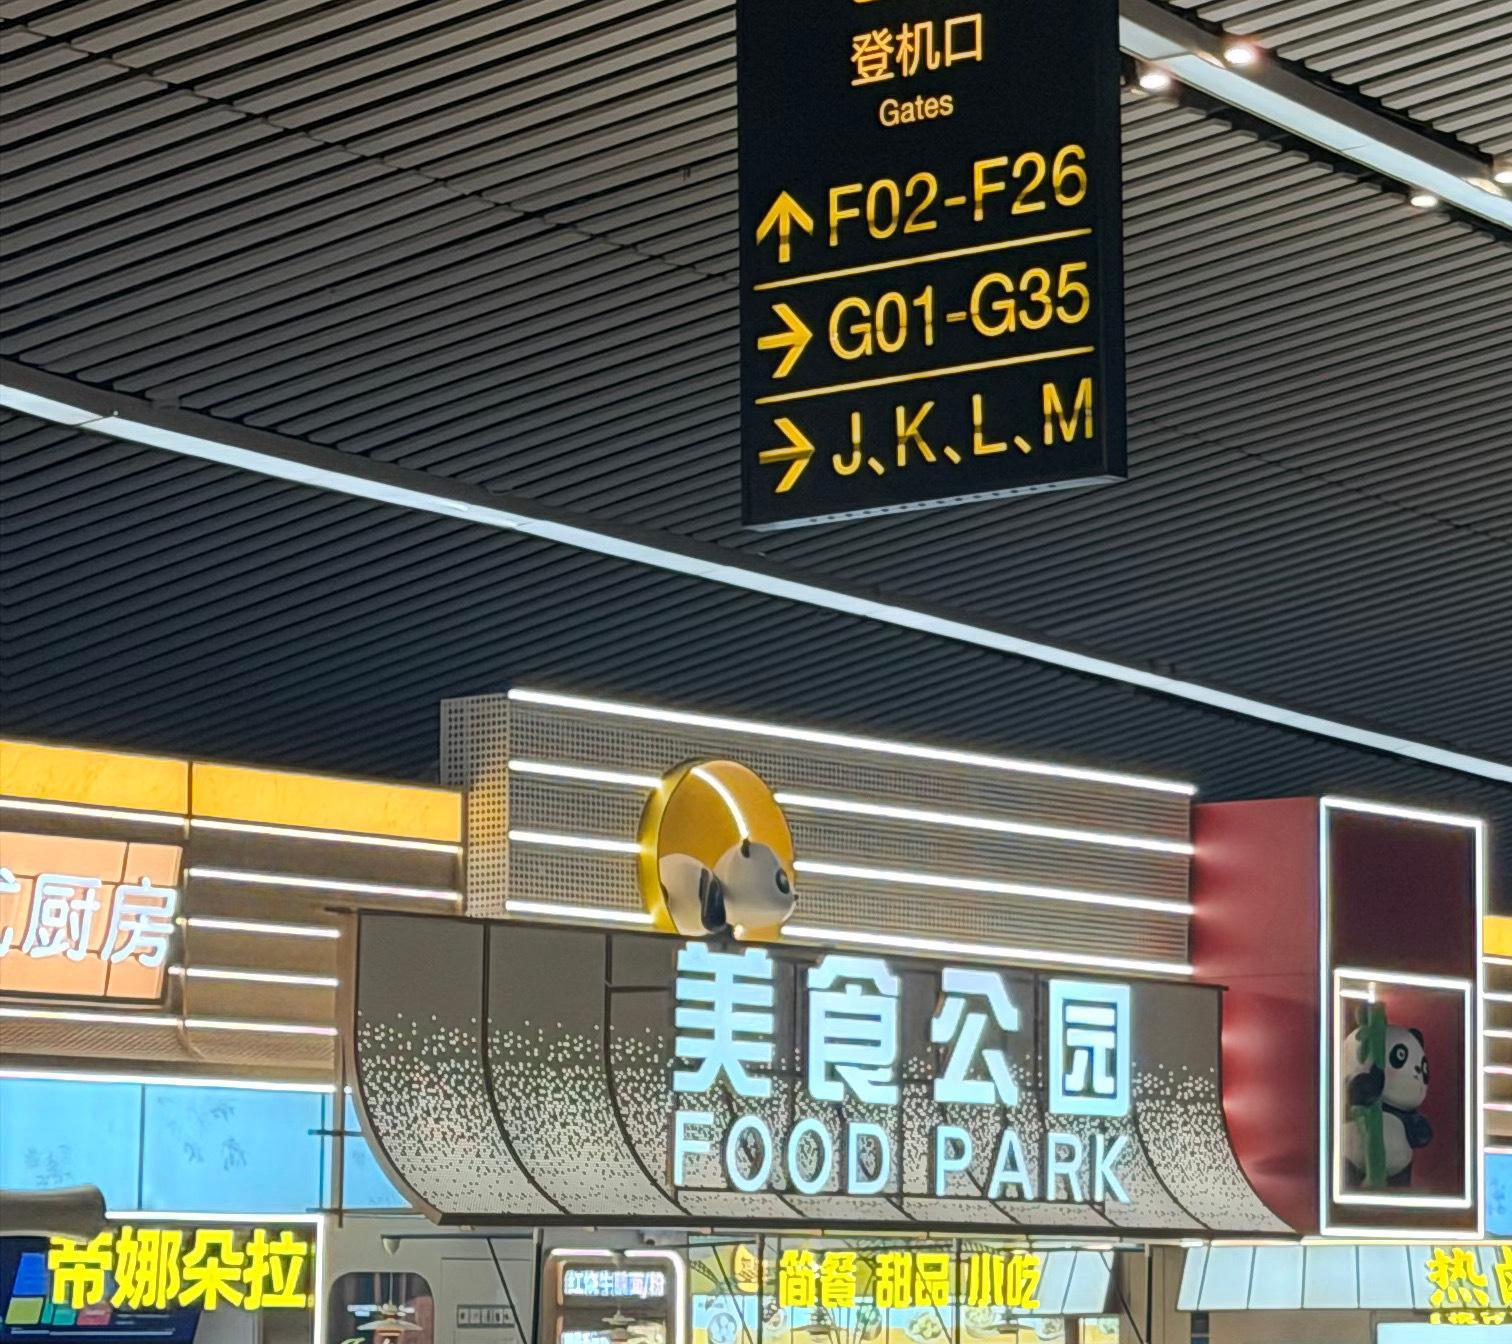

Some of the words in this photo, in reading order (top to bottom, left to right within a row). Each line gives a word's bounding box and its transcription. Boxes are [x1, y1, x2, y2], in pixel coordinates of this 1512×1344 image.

[850, 13, 984, 87] 登机口
[879, 92, 954, 129] Gates
[828, 144, 1088, 247] F02-F26
[829, 262, 1090, 361] G01-G35
[672, 942, 1132, 1117] 美食公园
[674, 1111, 892, 1196] FOOD
[934, 1124, 1132, 1205] PARK
[47, 1225, 309, 1310] 帝娜朵拉
[779, 1248, 858, 1309] 简餐
[876, 1252, 951, 1309] 甜品
[967, 1252, 1041, 1309] 小吃
